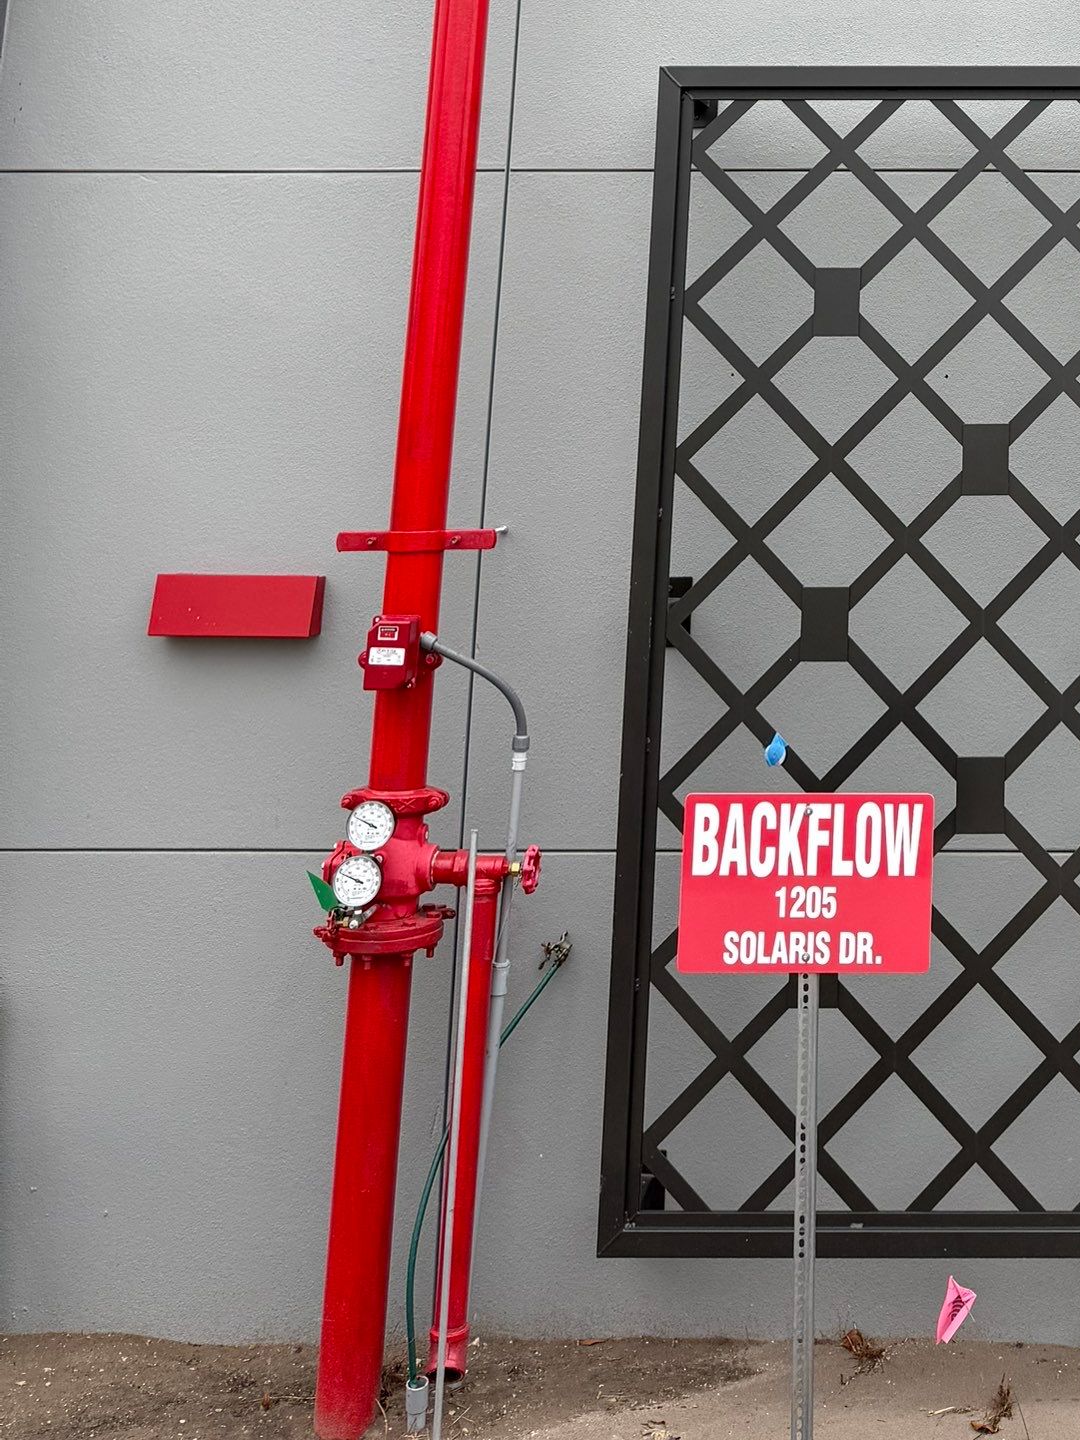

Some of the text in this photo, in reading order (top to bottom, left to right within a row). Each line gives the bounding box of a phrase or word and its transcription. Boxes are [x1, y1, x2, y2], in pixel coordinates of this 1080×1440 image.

[691, 801, 924, 878] BACKFLOW
[774, 885, 837, 919] 1205
[722, 930, 882, 965] SOLARIS DR.
